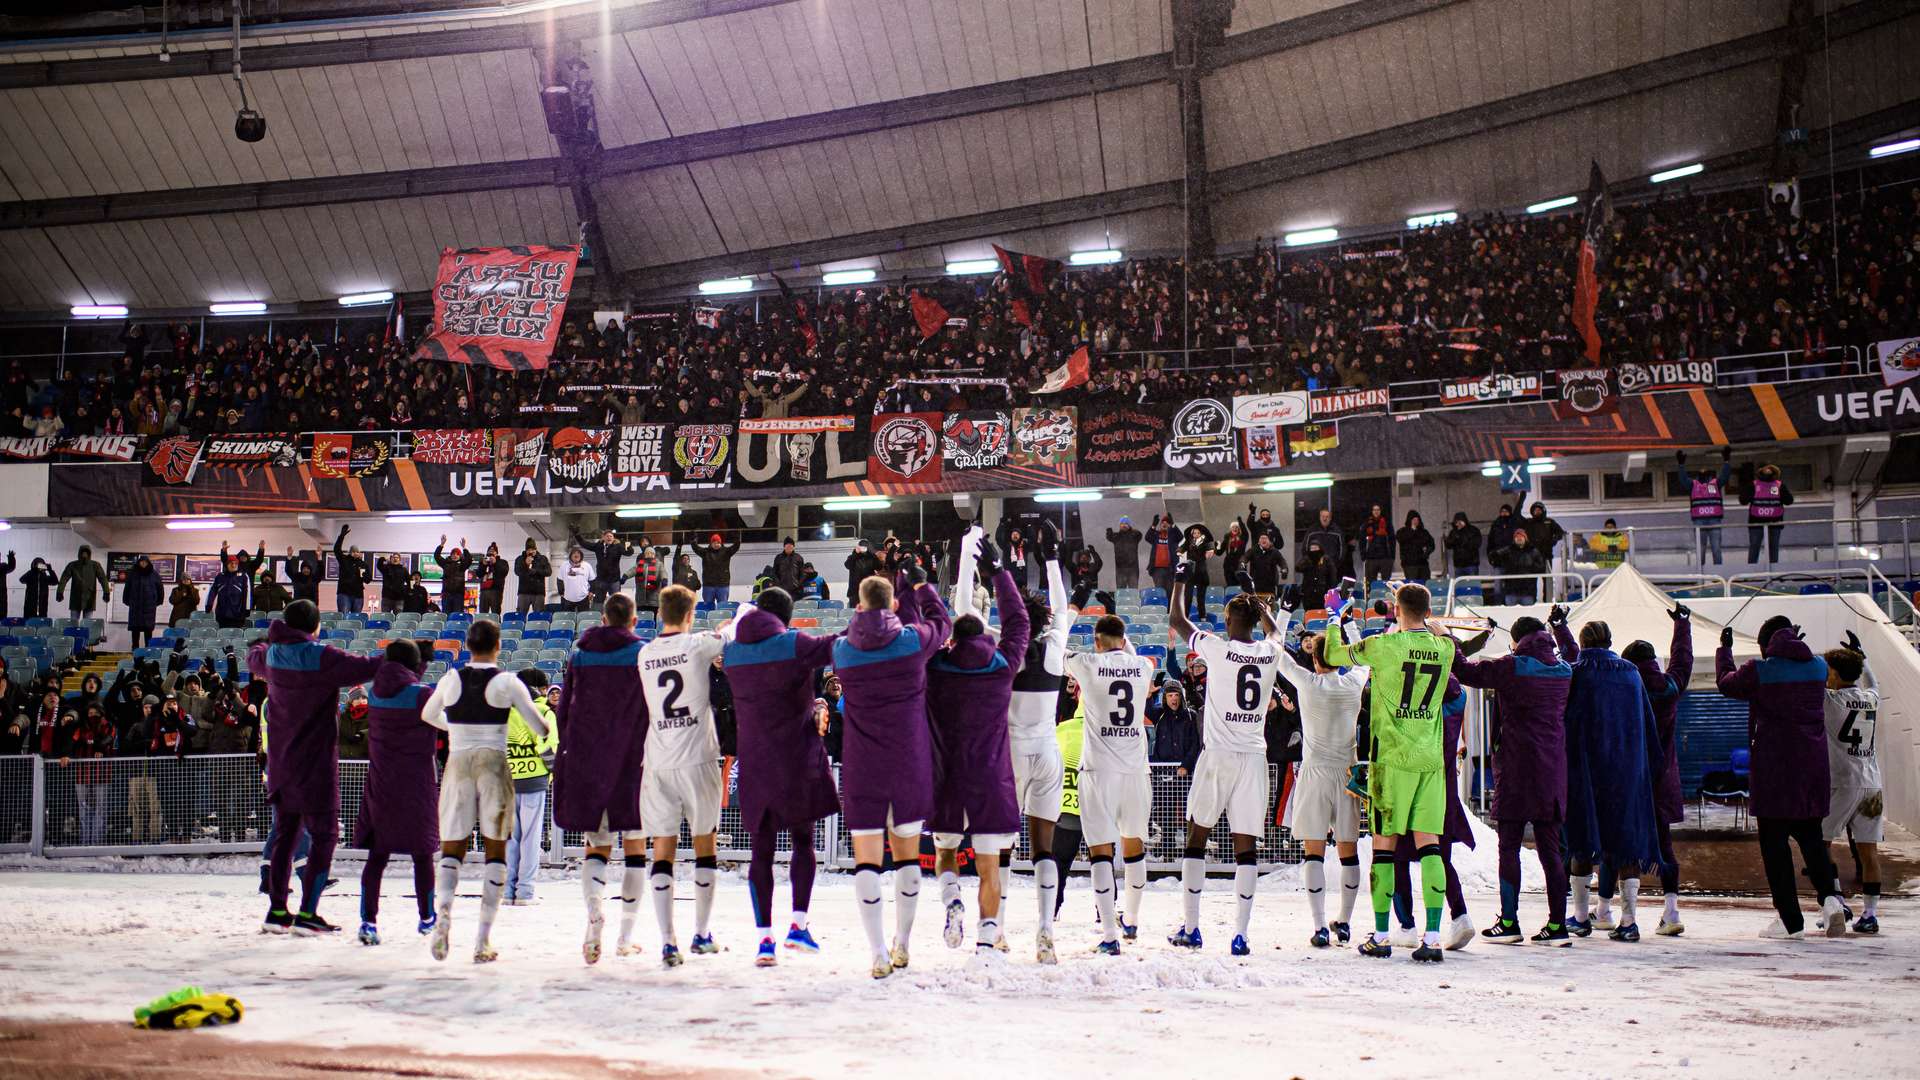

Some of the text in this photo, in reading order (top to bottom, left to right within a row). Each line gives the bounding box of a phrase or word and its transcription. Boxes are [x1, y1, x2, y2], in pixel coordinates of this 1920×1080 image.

[1649, 362, 1713, 384] YBL98
[1311, 388, 1387, 414] DJANGOS
[1816, 386, 1920, 422] UEFA
[621, 425, 666, 440] WEST
[617, 439, 662, 456] SIDE
[617, 455, 662, 473] BOYZ
[1508, 464, 1523, 485] X
[1758, 507, 1775, 516] 007
[645, 653, 689, 671] STANISIC
[1408, 649, 1440, 662] KOVAR
[1098, 666, 1142, 678] HINCAPIE
[657, 669, 691, 719] 2
[1236, 664, 1262, 711] 6
[1399, 661, 1443, 711] 17
[1108, 680, 1135, 727] 3
[1101, 726, 1130, 737] BAYER
